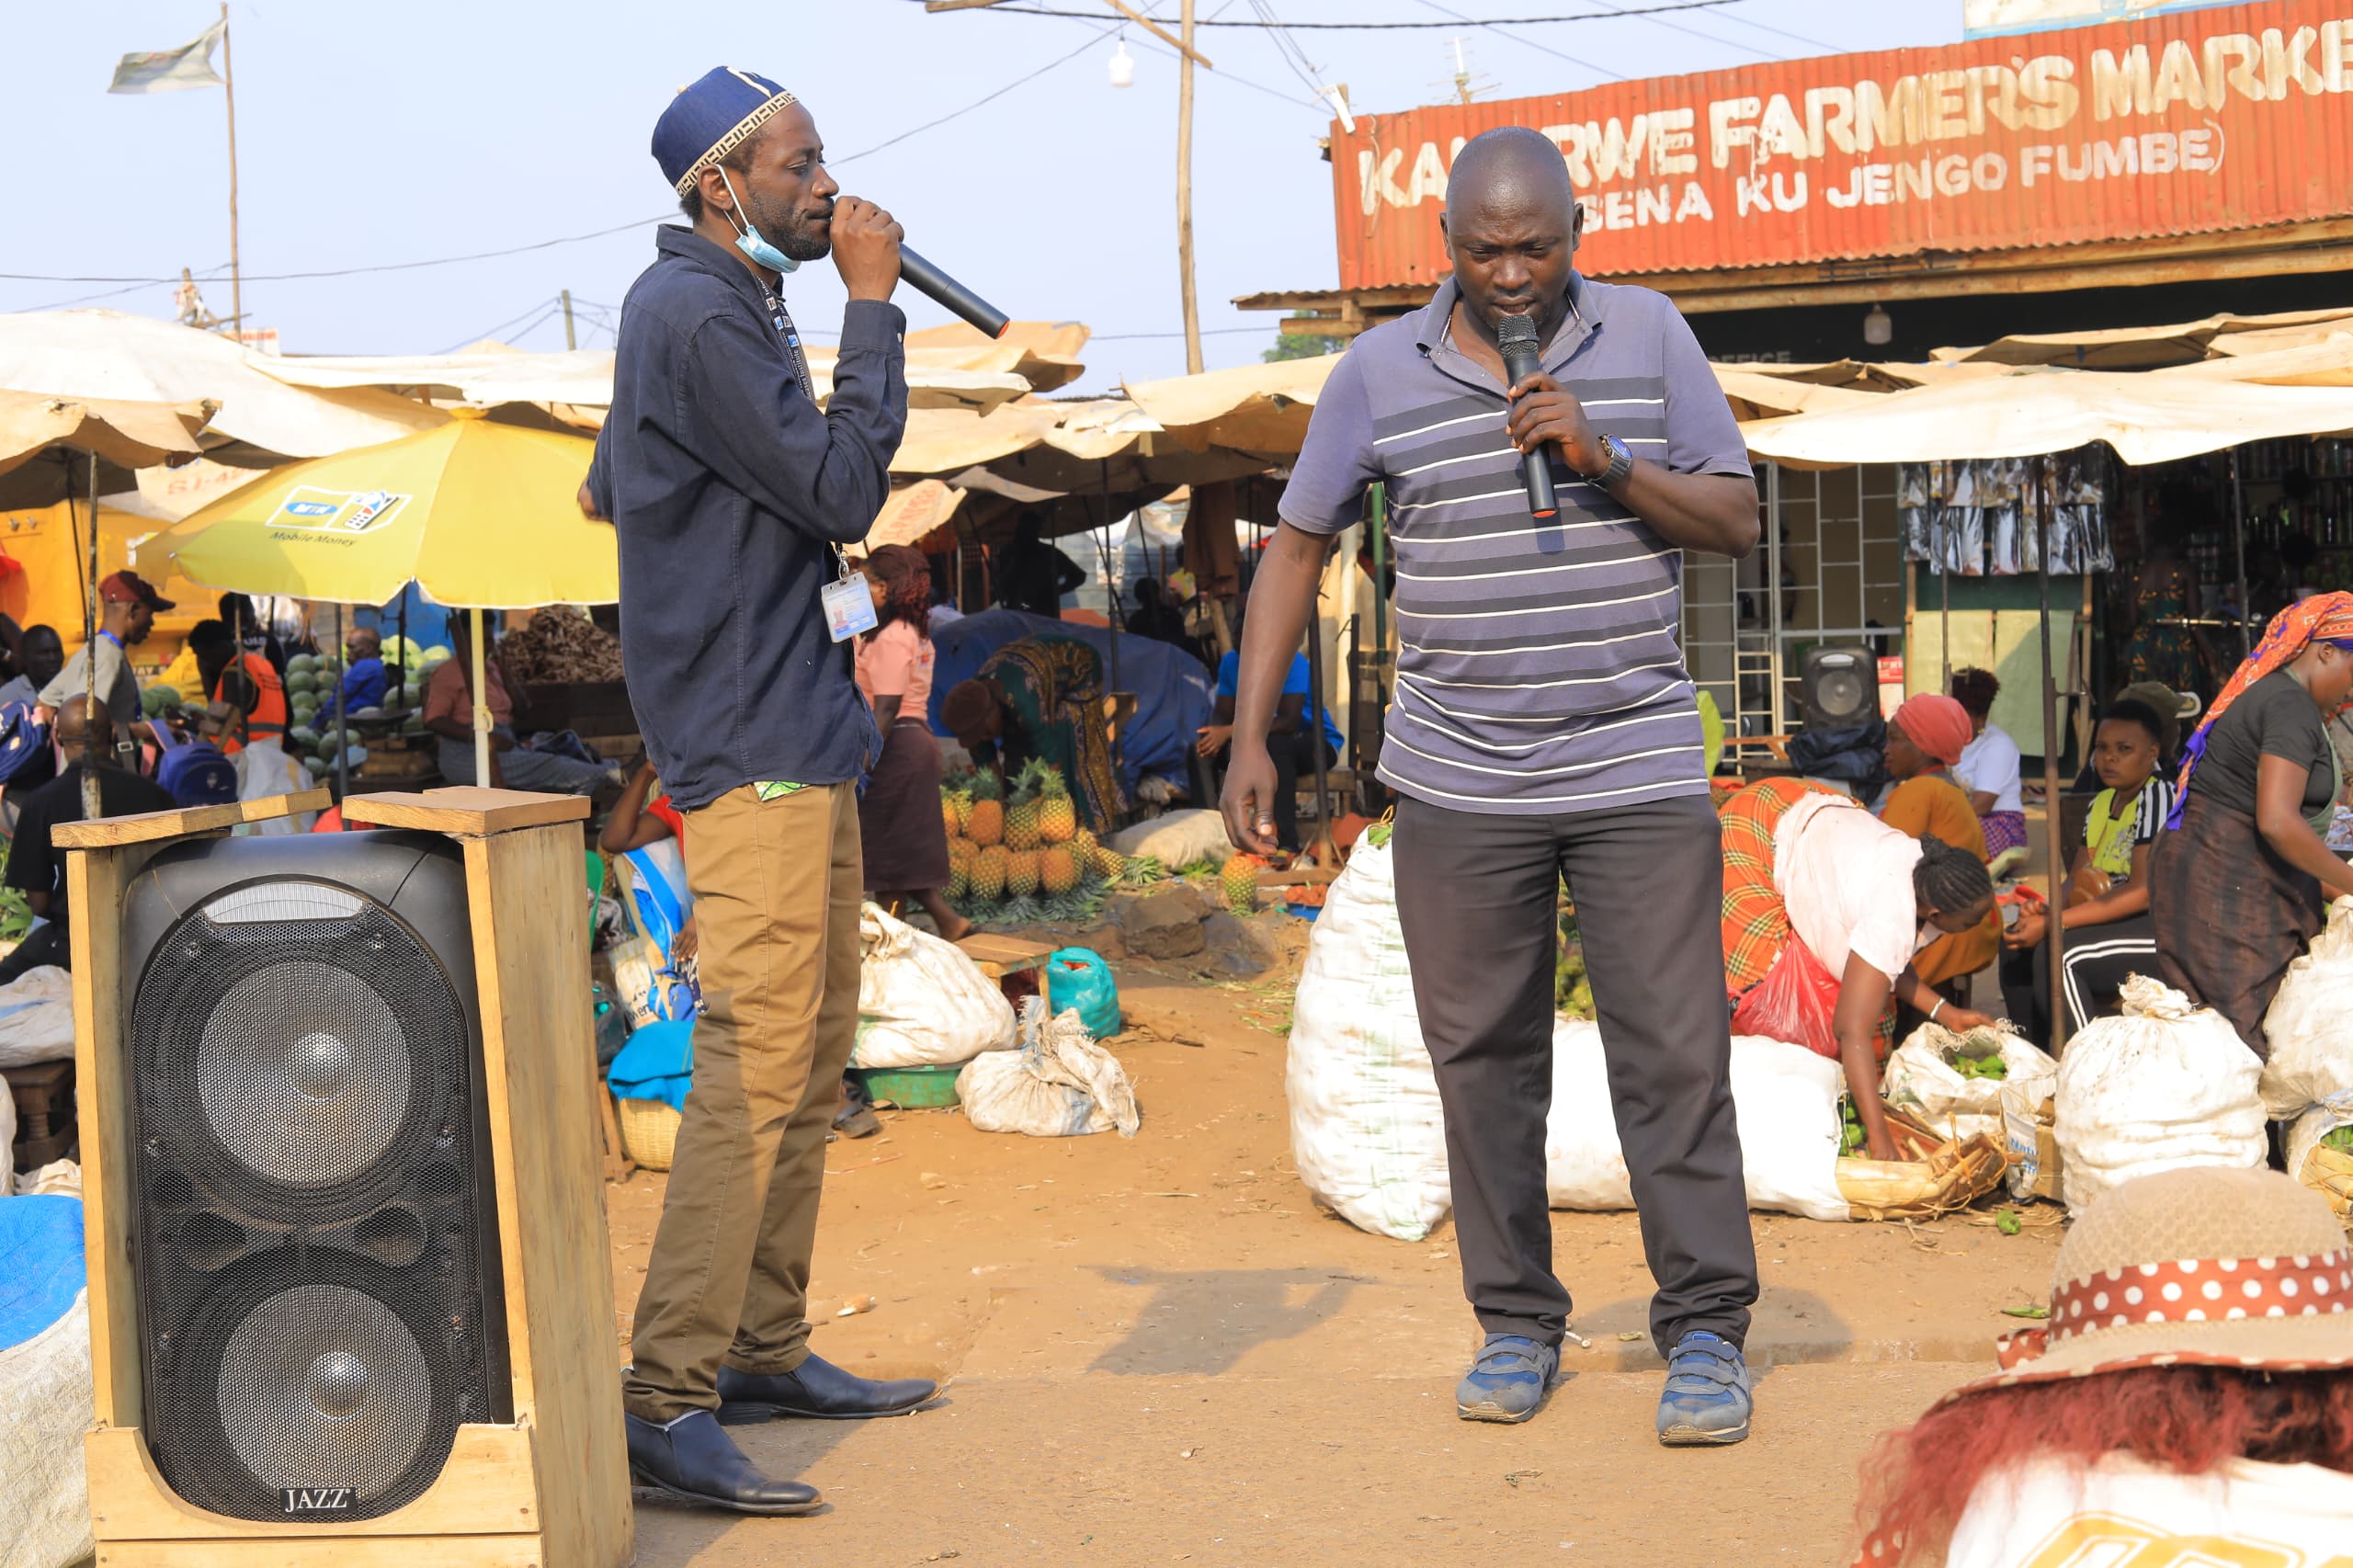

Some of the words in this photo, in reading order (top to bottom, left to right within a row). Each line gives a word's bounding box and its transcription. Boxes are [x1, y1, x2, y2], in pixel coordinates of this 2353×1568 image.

[1358, 108, 1699, 216] KARWE
[1710, 54, 2079, 169] FARMER'S
[1736, 171, 1809, 217] KU
[1826, 151, 2007, 209] JENGO
[2021, 119, 2225, 187] FUMBE)
[269, 530, 313, 542] Mobile
[314, 533, 358, 547] Money
[285, 1488, 347, 1512] JAZZ
